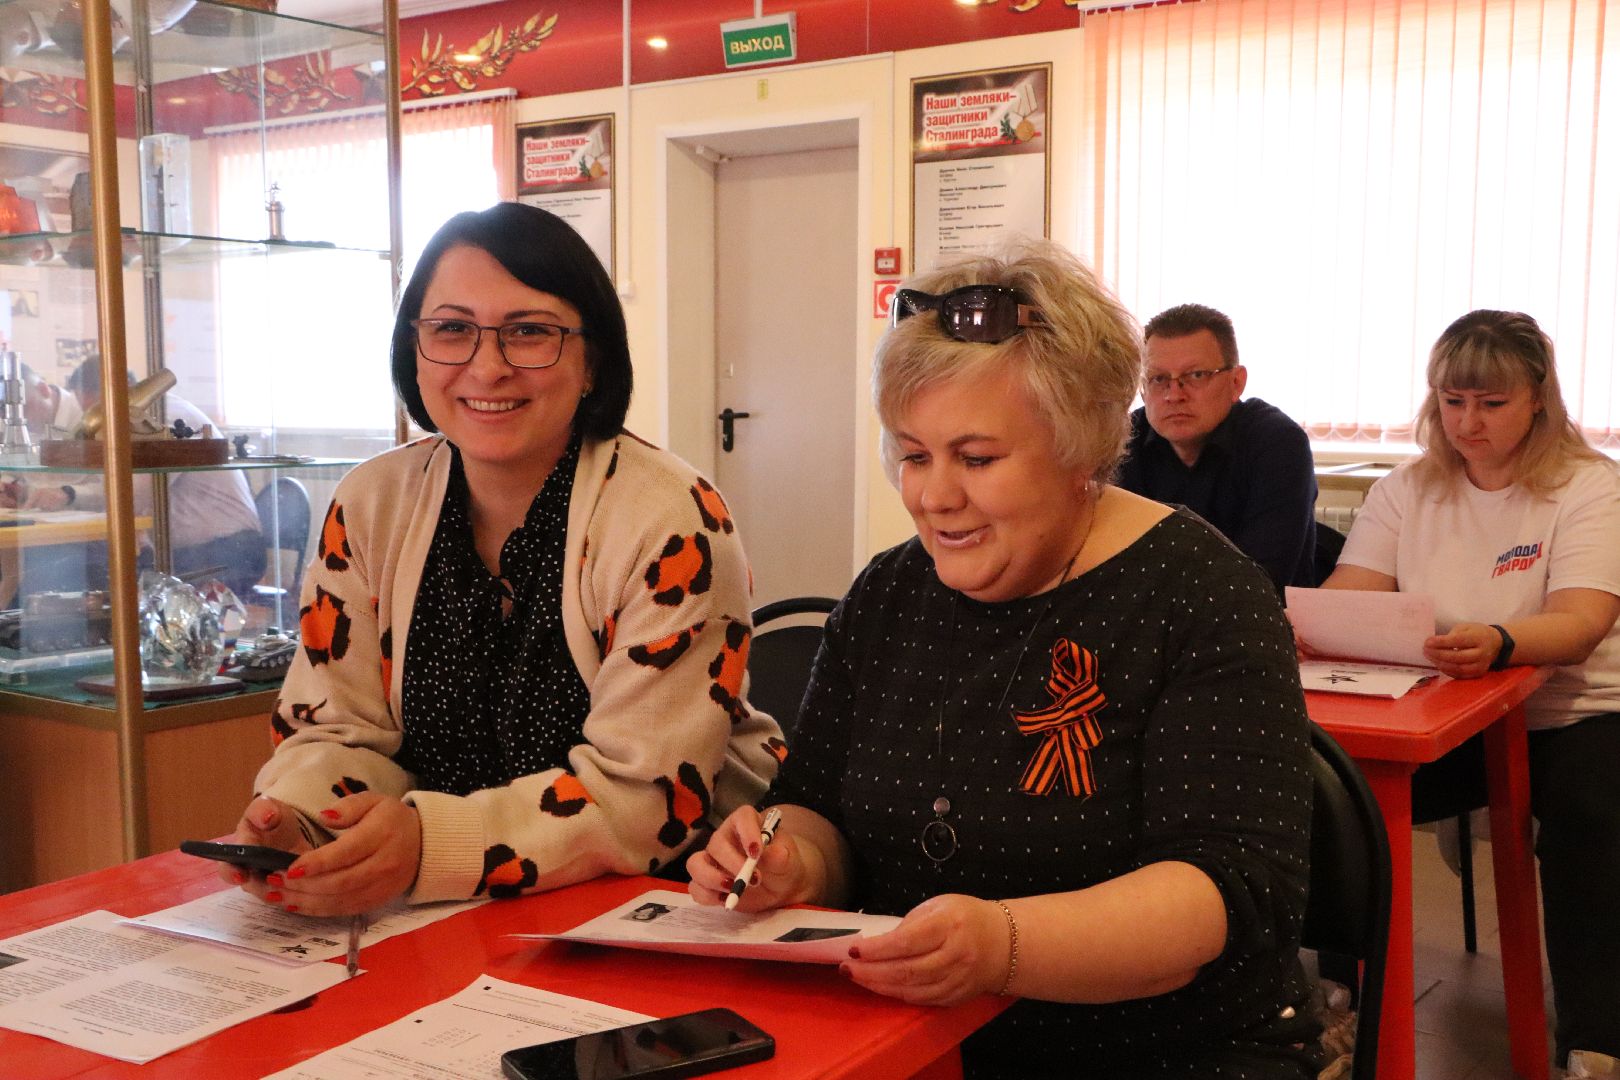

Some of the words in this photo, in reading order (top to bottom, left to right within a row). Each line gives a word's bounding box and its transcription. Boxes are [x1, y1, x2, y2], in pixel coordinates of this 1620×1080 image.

[730, 34, 785, 55] ВЫХОД
[926, 97, 957, 111] Наши
[926, 112, 988, 127] защитники
[926, 126, 999, 144] Сталинграда
[526, 141, 548, 151] Наши
[526, 153, 570, 165] защитники
[526, 165, 578, 180] Сталинграда
